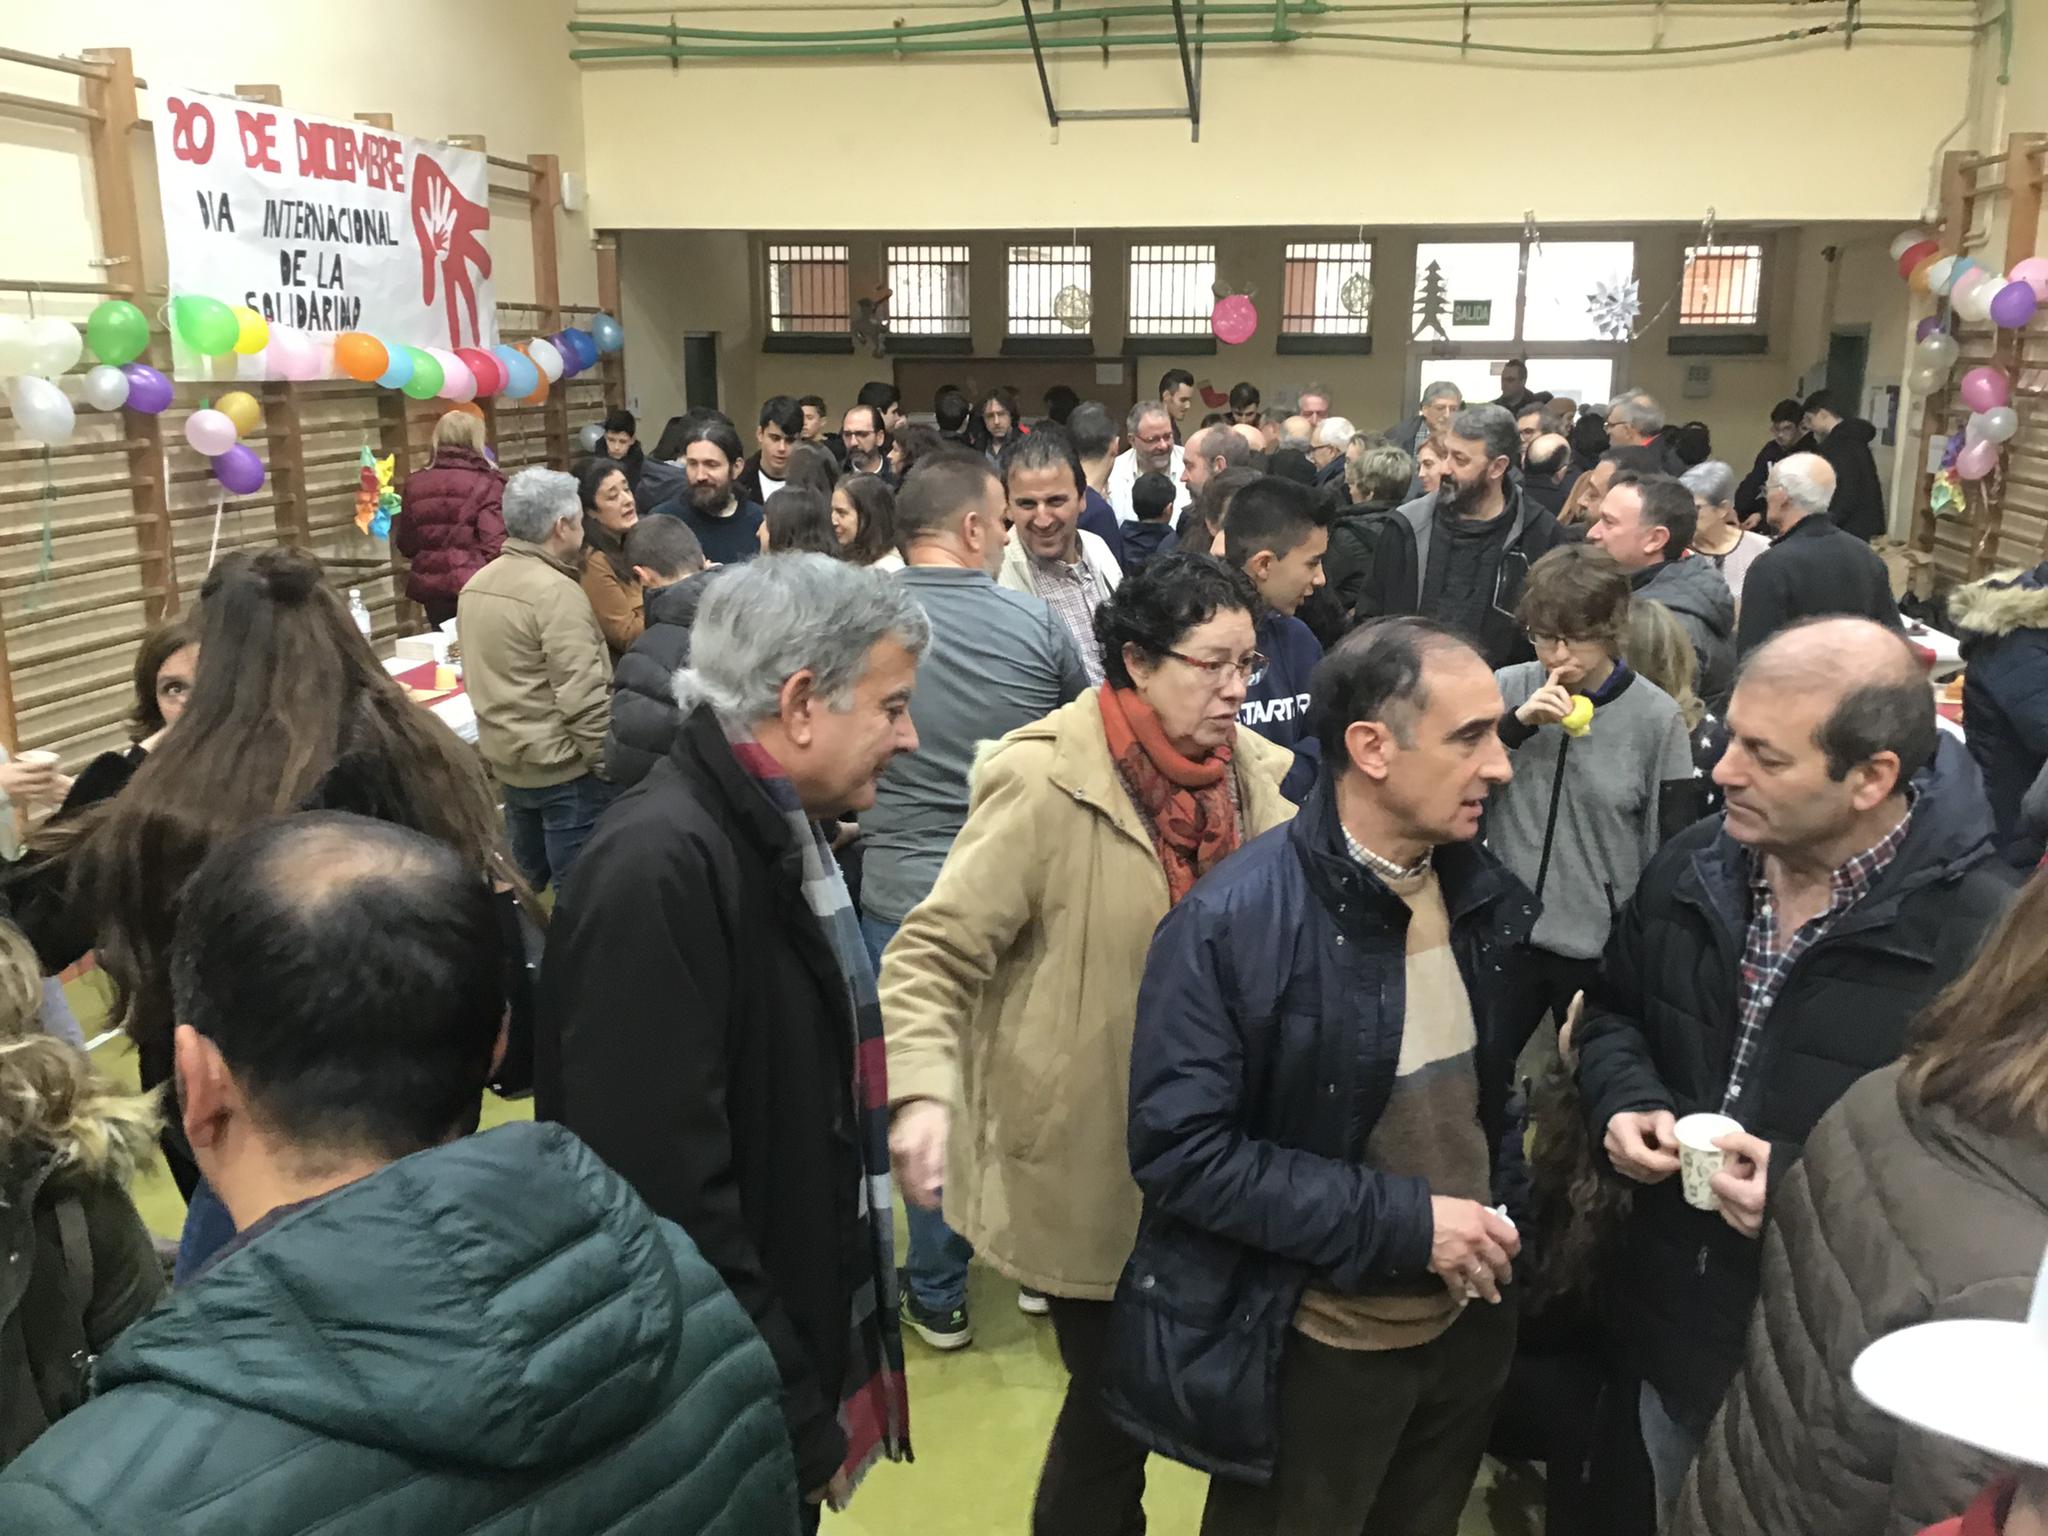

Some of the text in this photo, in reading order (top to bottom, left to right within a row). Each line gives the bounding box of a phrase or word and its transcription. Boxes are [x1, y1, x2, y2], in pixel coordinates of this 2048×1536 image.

[167, 96, 405, 193] 20 DE DICIEMBRE
[196, 189, 399, 246] DIA INTERNACIONAL
[280, 249, 344, 290] DE LA
[245, 290, 361, 332] SOLIDARIDAD
[1455, 304, 1489, 321] SALIDA
